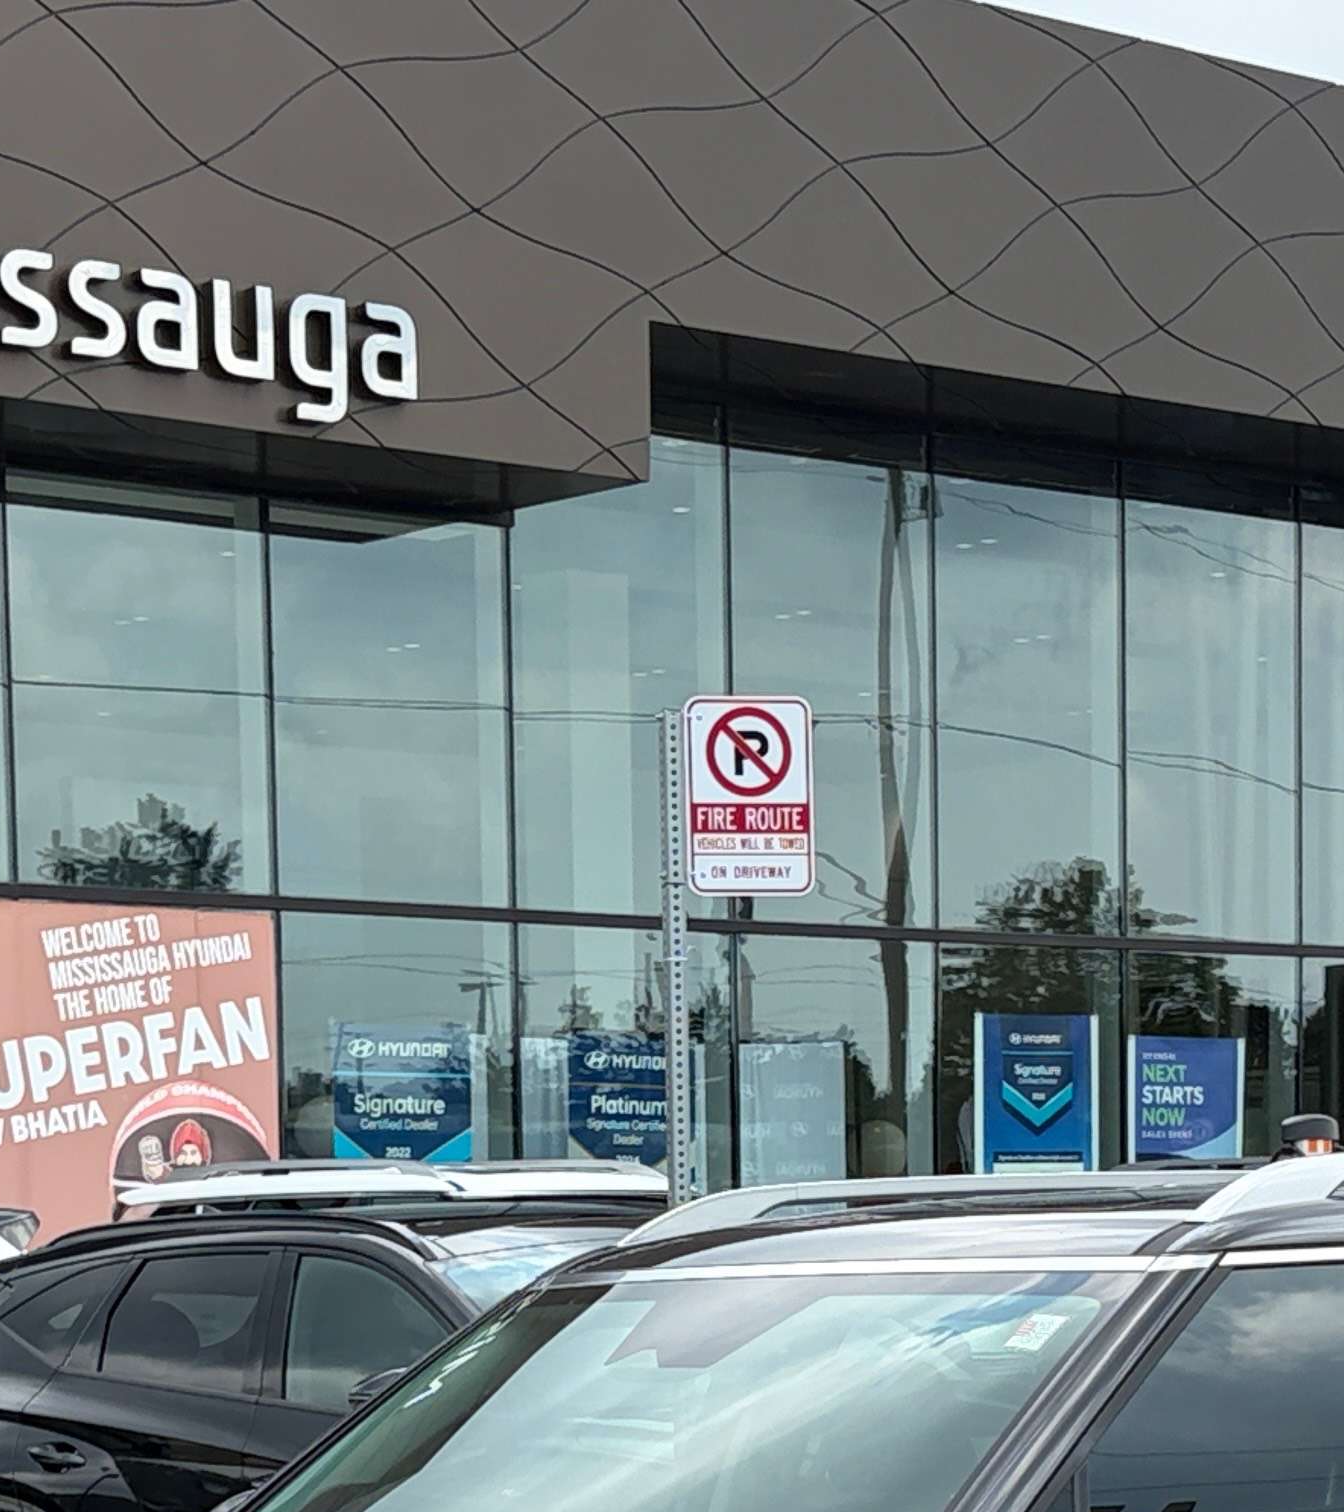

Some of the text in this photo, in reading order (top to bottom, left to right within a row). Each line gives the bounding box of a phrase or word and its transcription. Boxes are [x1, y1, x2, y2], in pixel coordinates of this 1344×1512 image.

[696, 807, 804, 831] FIRE ROUTE
[697, 837, 737, 850] VEHICLES
[741, 838, 761, 850] WILL
[764, 838, 774, 850] BE
[711, 866, 792, 879] ON DRIVEWAY
[41, 913, 161, 959] WELCOME TO
[48, 932, 253, 990] MISSISSAUGA HYUNDAI
[53, 975, 174, 1022] THE HOME OF
[378, 1041, 452, 1058] HYUNDAI
[612, 1054, 667, 1071] HYUND
[1142, 1063, 1188, 1083] NEXT
[1141, 1085, 1205, 1105] STARTS
[354, 1094, 446, 1118] Signature
[591, 1095, 668, 1116] Platinum
[10, 1100, 109, 1144] BHATIA
[631, 1119, 668, 1132] Certifie
[1141, 1107, 1186, 1126] NOW
